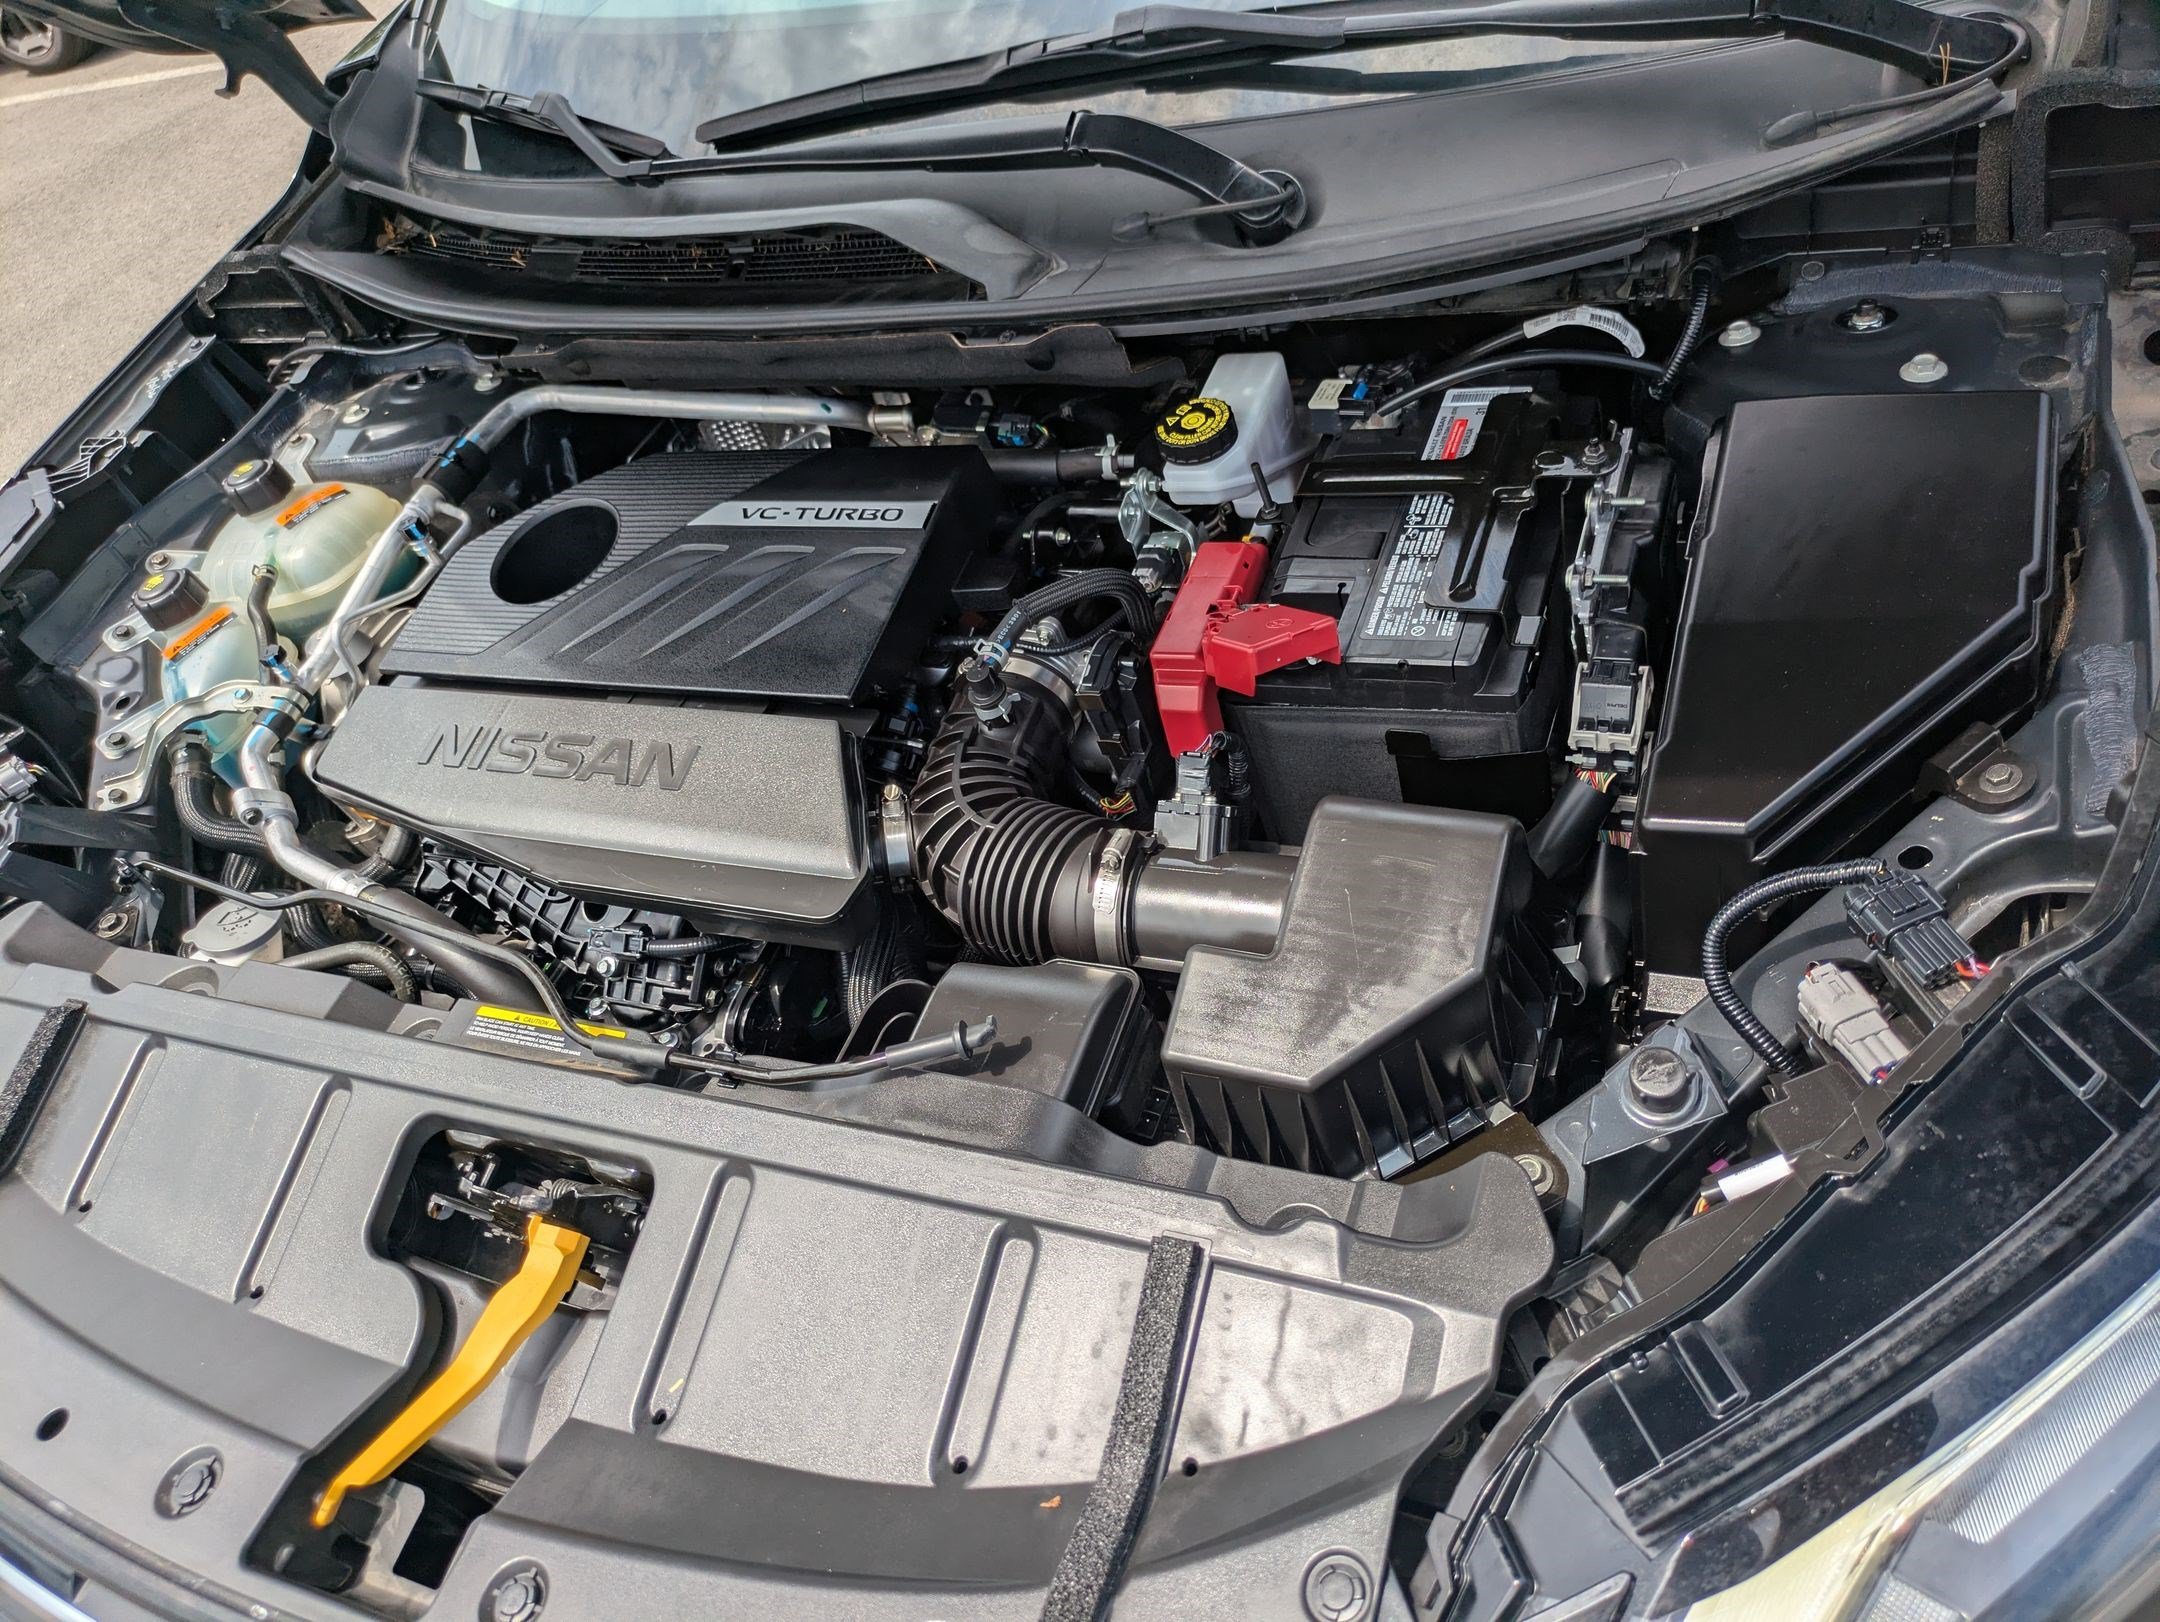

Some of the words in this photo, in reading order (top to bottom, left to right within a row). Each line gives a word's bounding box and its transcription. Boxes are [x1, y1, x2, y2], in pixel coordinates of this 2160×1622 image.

[742, 507, 904, 522] VC-TURBO
[417, 724, 701, 791] NISSAN
[523, 1016, 549, 1027] CAUTION
